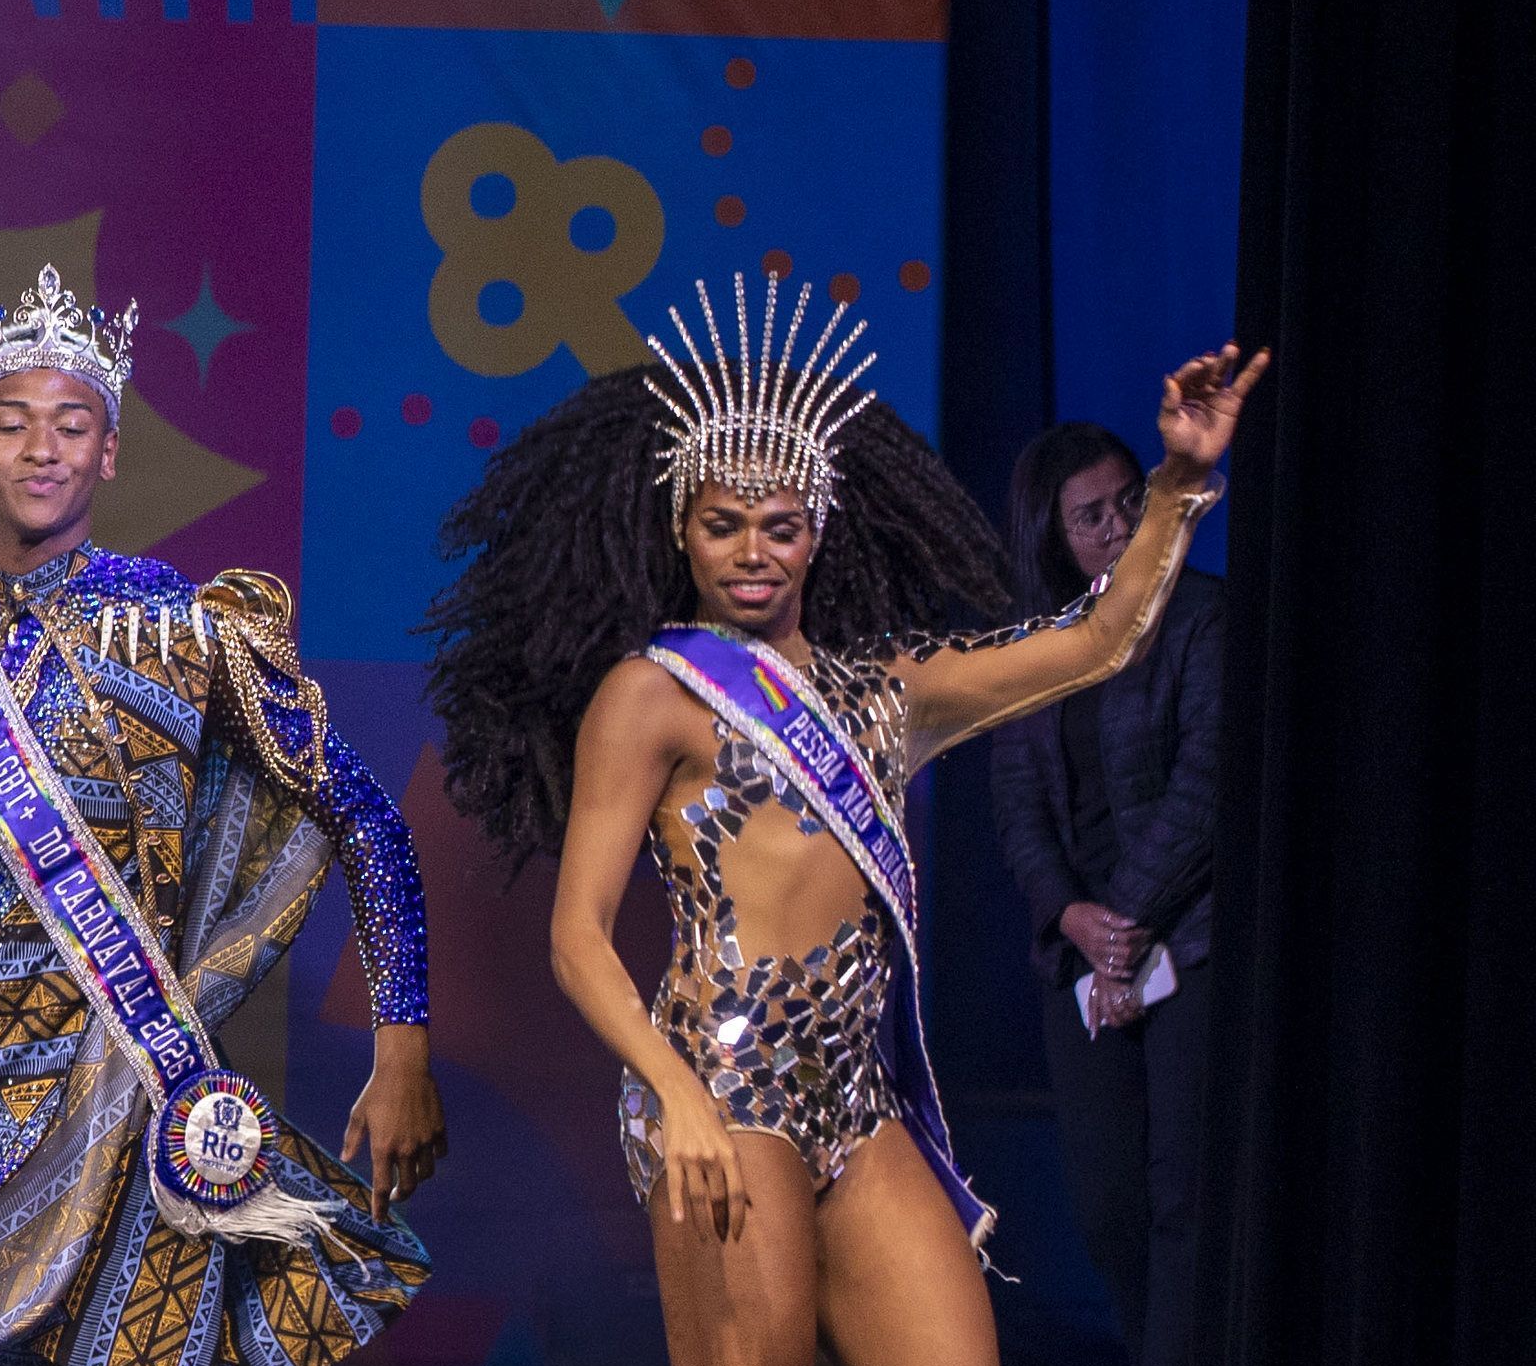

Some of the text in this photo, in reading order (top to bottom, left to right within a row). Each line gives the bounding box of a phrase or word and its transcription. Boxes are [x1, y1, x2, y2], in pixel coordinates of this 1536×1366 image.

[783, 711, 846, 788] PESSOA
[28, 826, 69, 870] DO
[52, 869, 154, 1017] CARNAVAL
[140, 1011, 200, 1082] 2026
[202, 1128, 243, 1161] Rio
